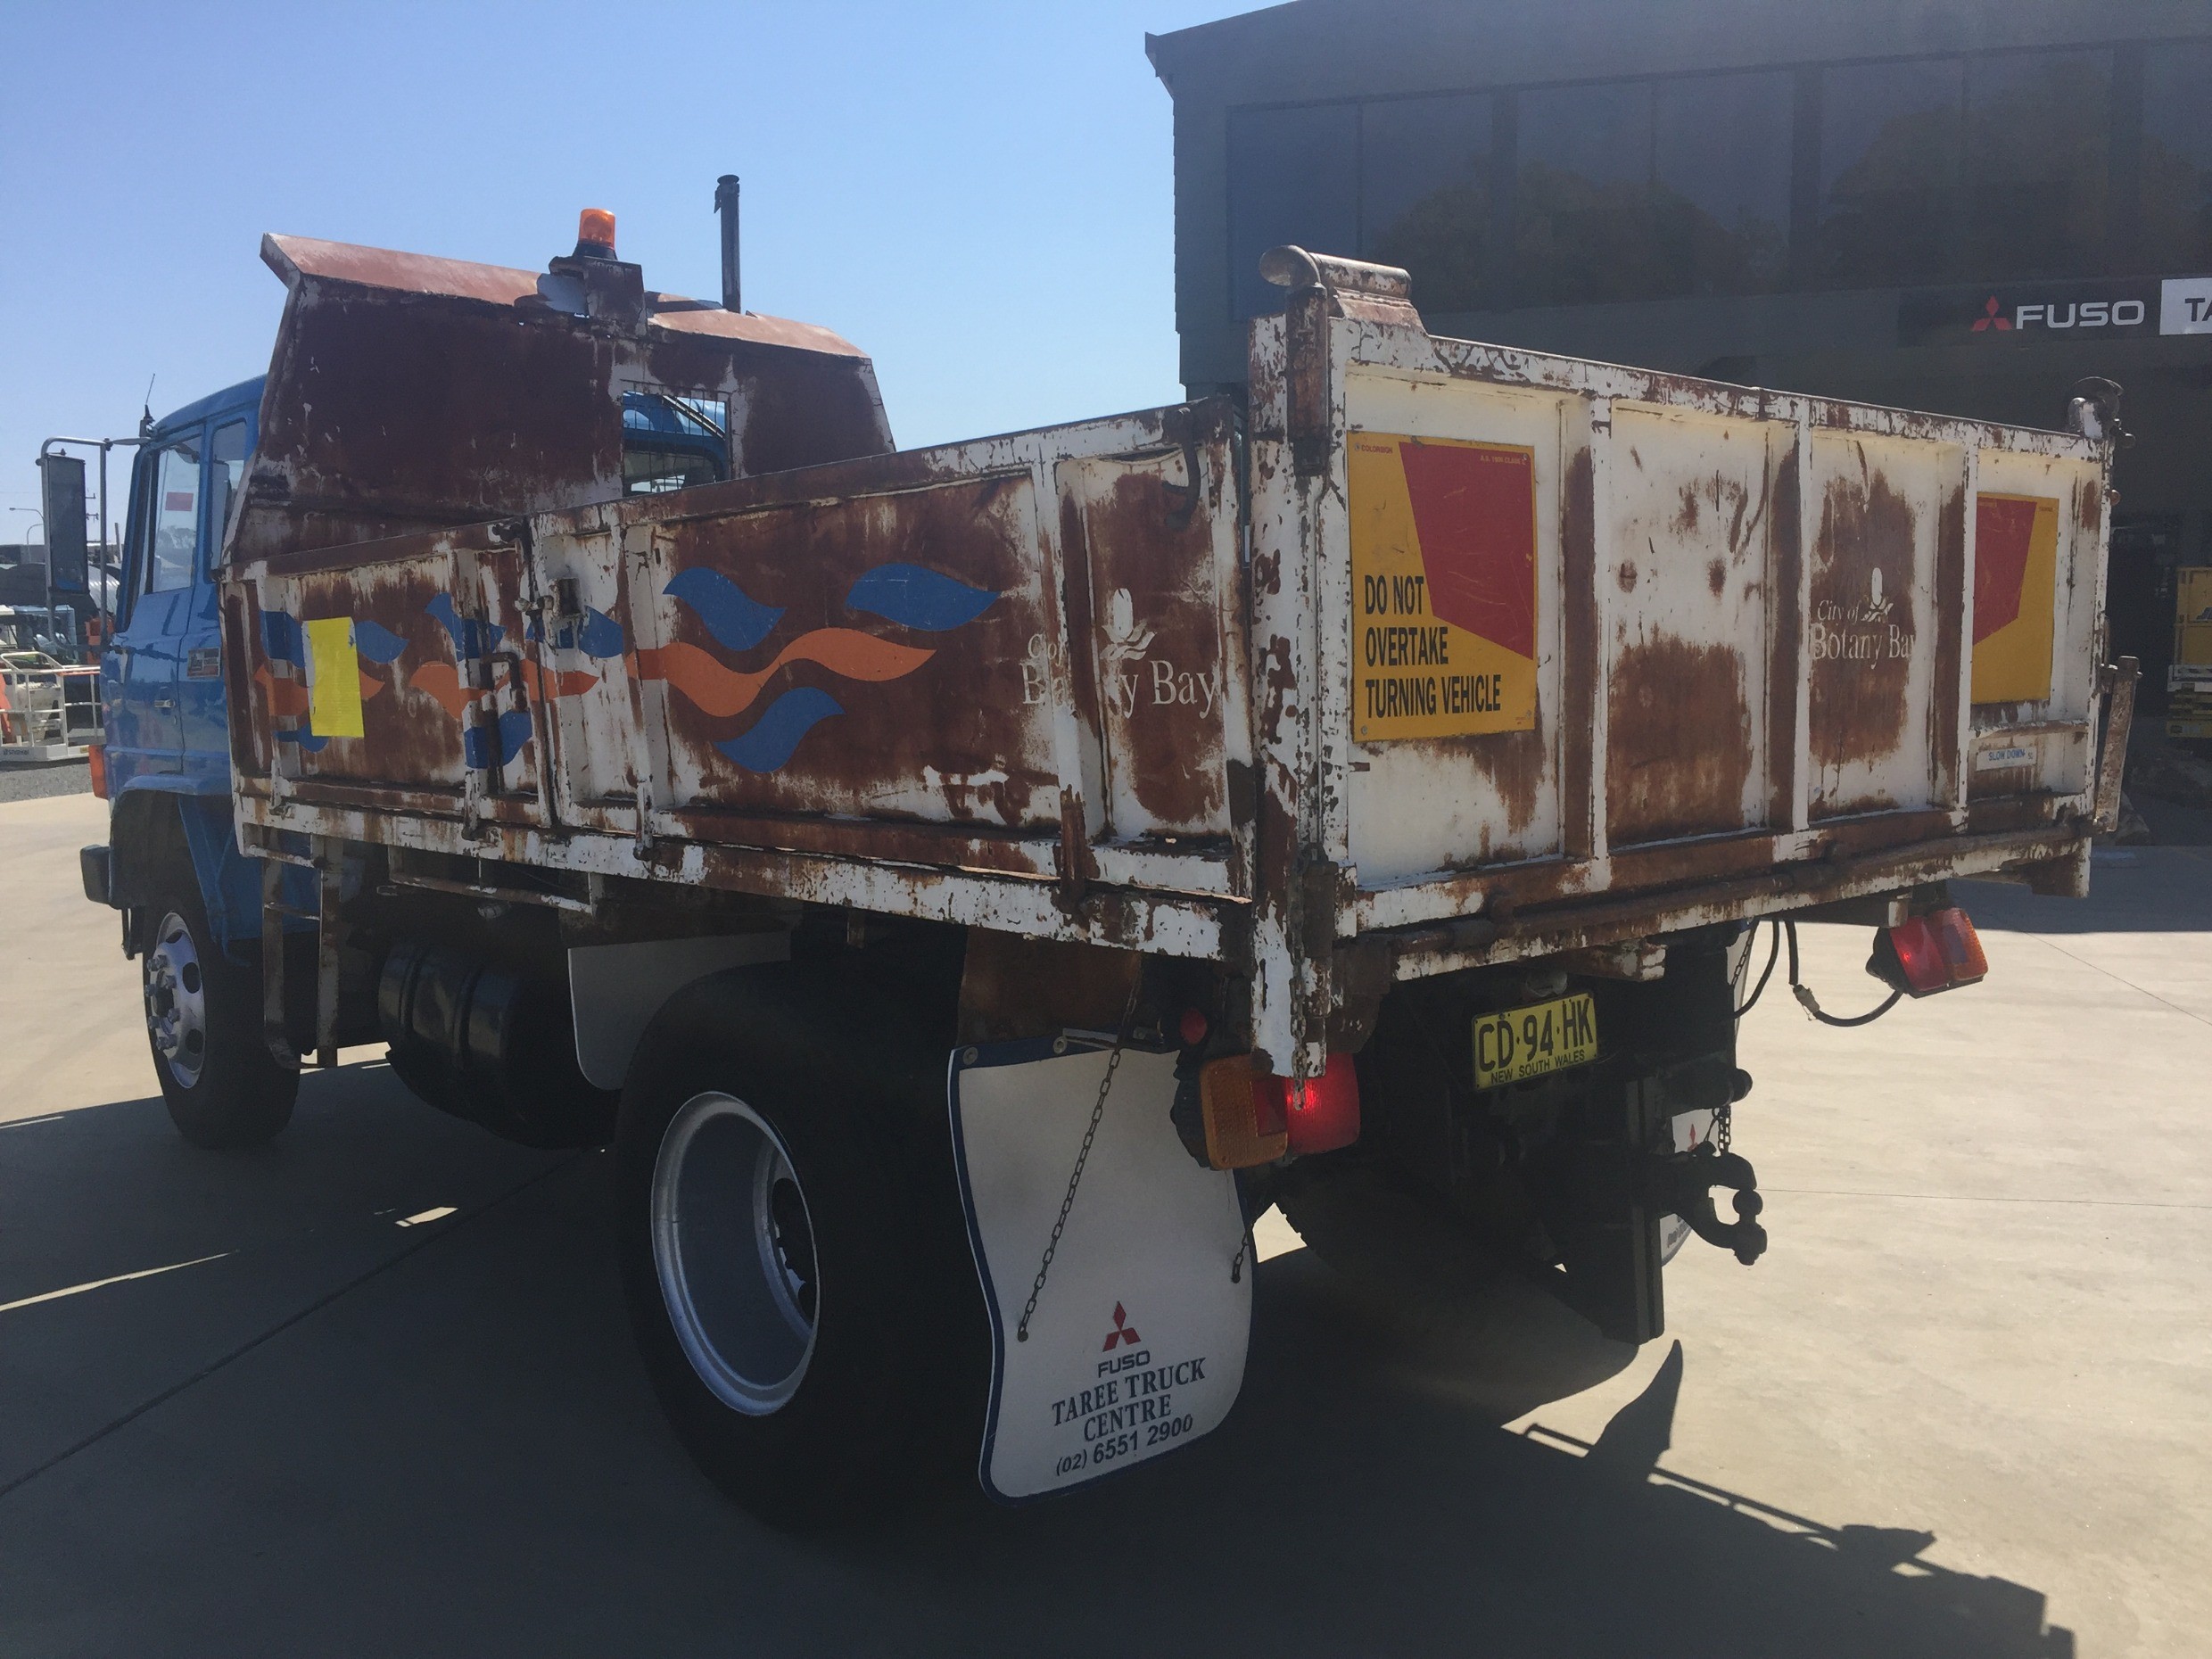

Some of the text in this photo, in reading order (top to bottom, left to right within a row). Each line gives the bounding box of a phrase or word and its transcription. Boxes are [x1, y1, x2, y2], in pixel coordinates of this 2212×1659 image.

[2016, 301, 2144, 330] FUSO
[1365, 574, 1424, 615] DO NOT
[1366, 626, 1449, 667] OVERTAKE
[1810, 622, 1883, 670] Botany
[1151, 660, 1222, 720] Bay
[1366, 673, 1502, 719] TURNING VEHICLE
[1988, 750, 2005, 761] SLOW
[2007, 748, 2026, 759] DOWN
[1490, 1049, 1585, 1085] NEW SOUTH WALES
[1098, 1349, 1151, 1378] FUSO
[1052, 1357, 1206, 1426] TAREE TRUCK
[1084, 1393, 1172, 1442] CENTRE
[1055, 1413, 1193, 1476] (02) 6551 2900
